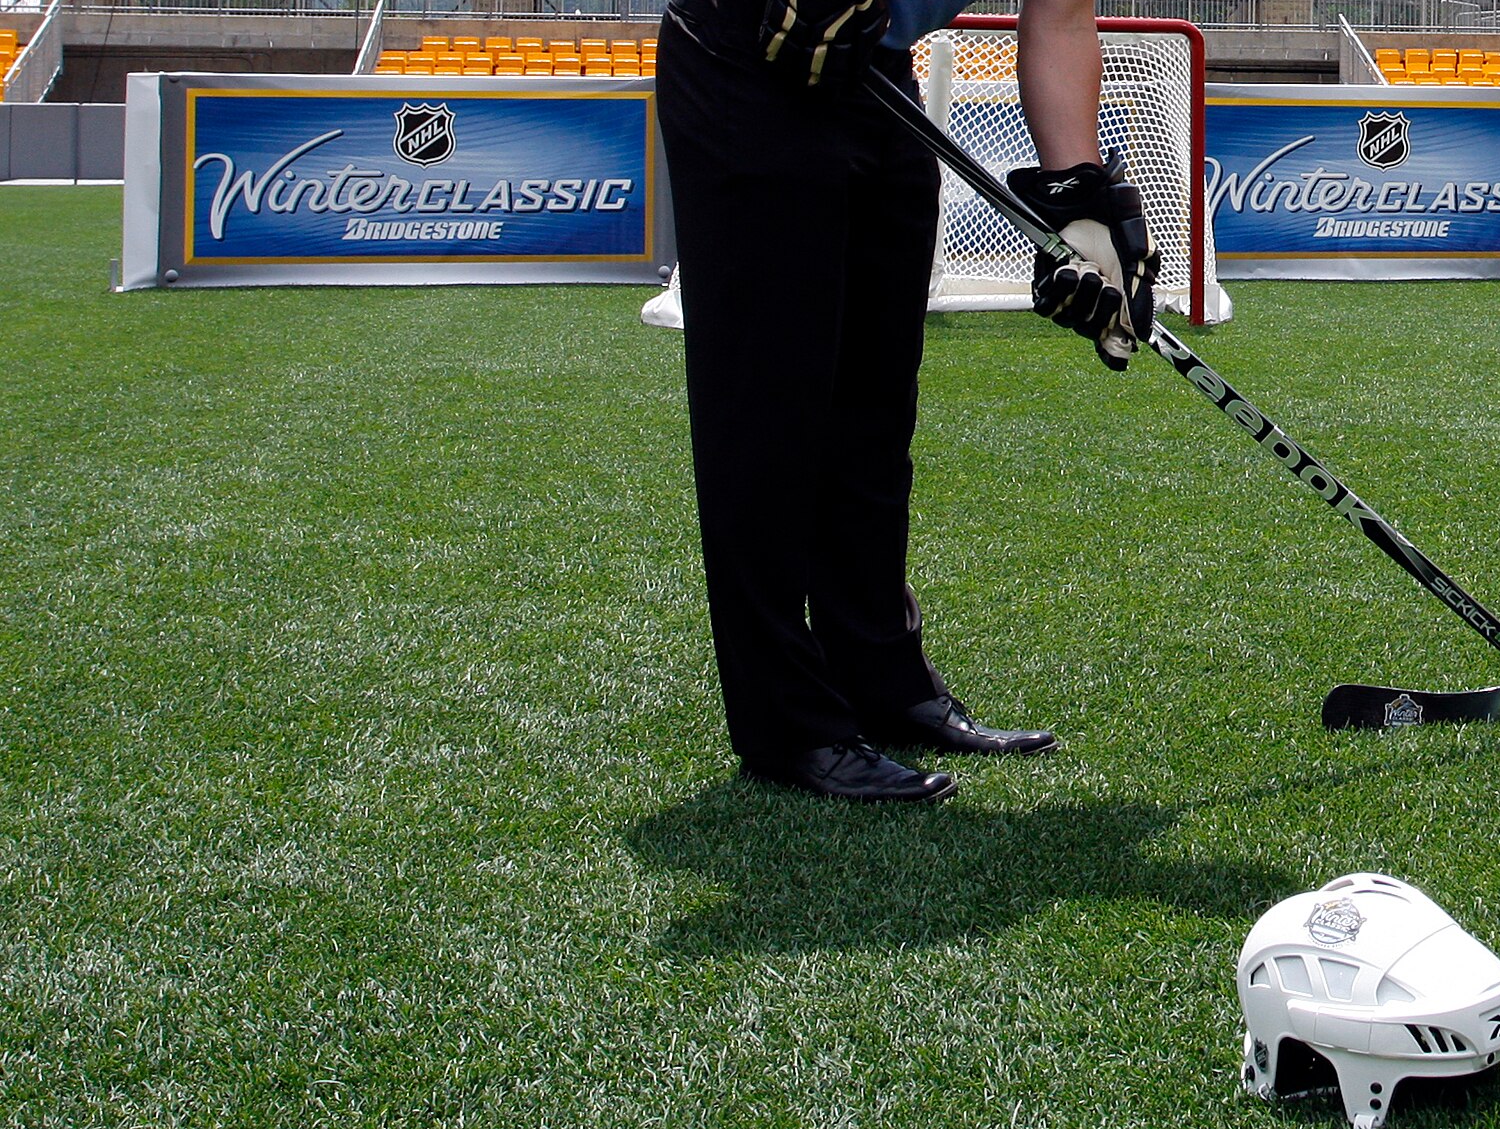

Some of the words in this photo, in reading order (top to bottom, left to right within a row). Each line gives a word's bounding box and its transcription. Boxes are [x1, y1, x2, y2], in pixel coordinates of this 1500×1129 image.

[406, 119, 445, 155] NHL
[1367, 128, 1401, 159] NHL
[192, 128, 420, 241] Winter
[413, 178, 634, 214] CLASSIC
[1204, 135, 1377, 219] Winter
[342, 218, 504, 242] BRIDGESTONE
[1312, 221, 1451, 239] BRIDGESTONE
[1151, 328, 1384, 534] Reebok
[1429, 575, 1497, 637] SICKICK
